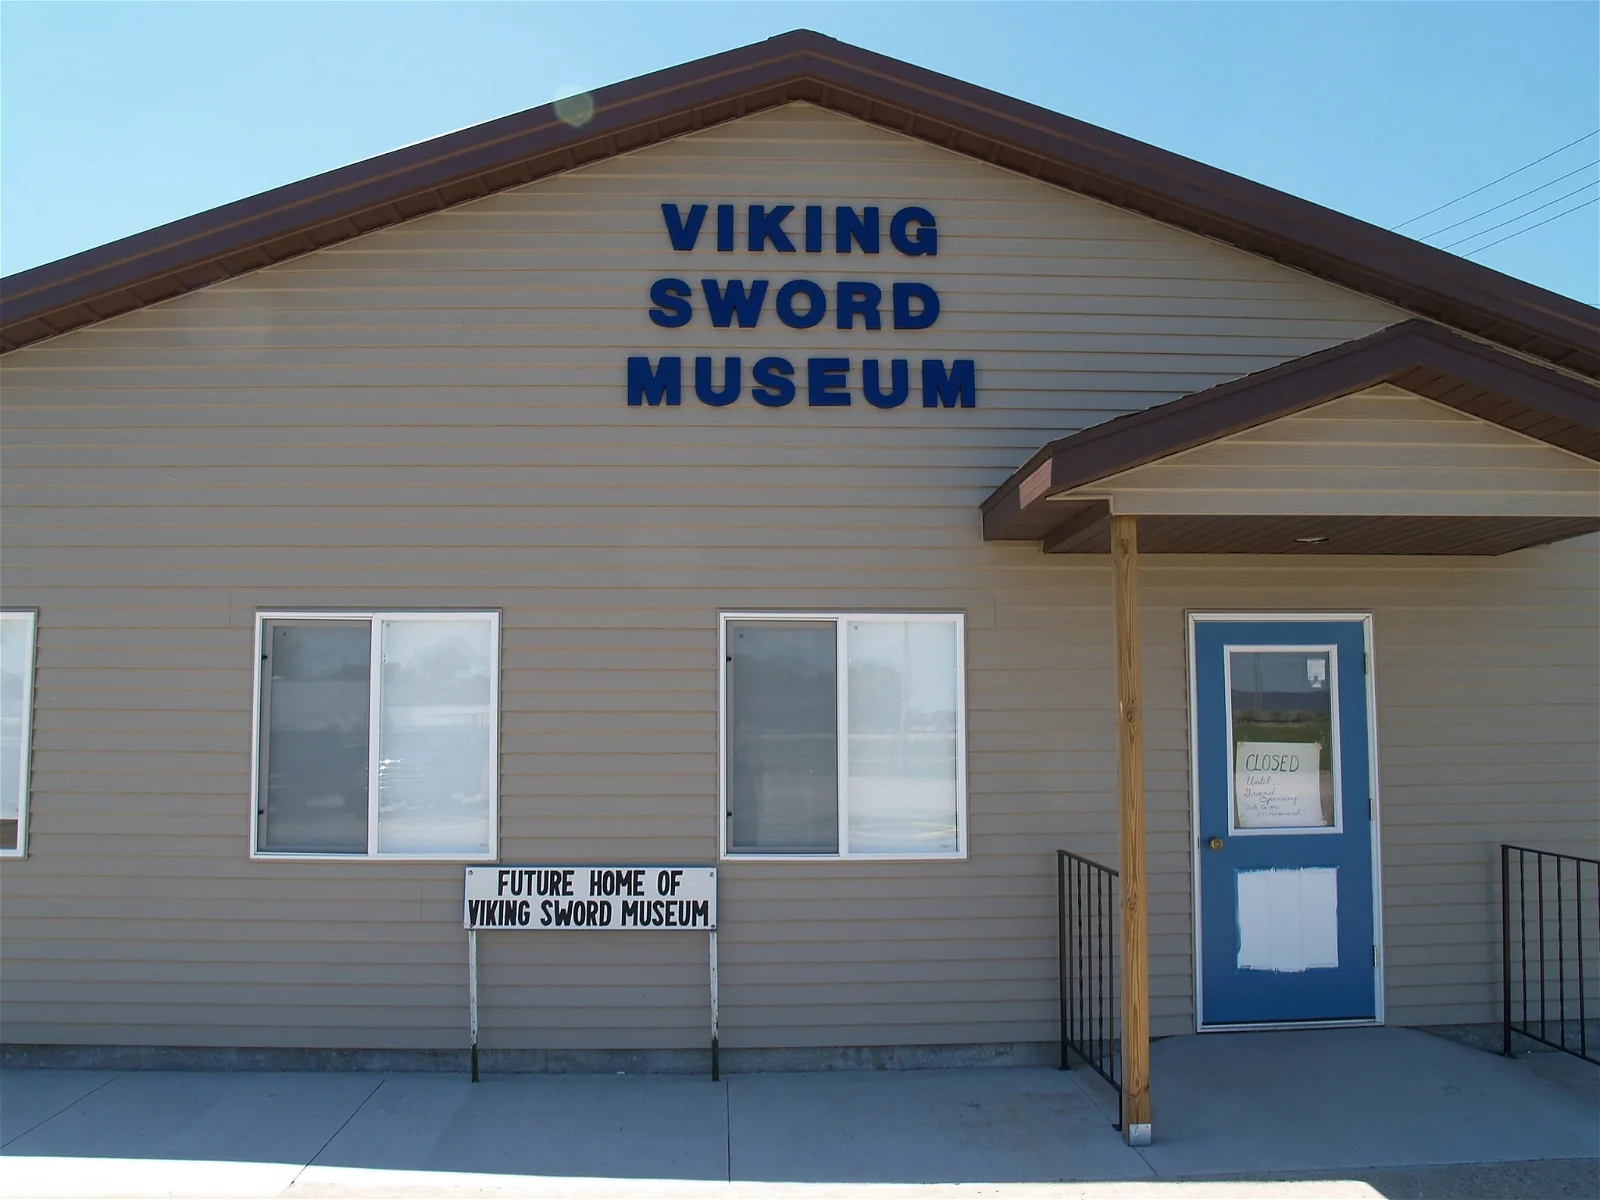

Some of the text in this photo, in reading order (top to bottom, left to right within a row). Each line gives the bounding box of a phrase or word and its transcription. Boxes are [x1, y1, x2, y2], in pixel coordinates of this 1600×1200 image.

[661, 203, 938, 256] VIKING
[648, 278, 940, 329] SWORD
[627, 356, 976, 408] MUSEUM
[1245, 753, 1300, 772] CLOSED
[498, 870, 683, 896] FUTURE HOME OF
[468, 900, 709, 926] VIKING SWORD MUSEUM
